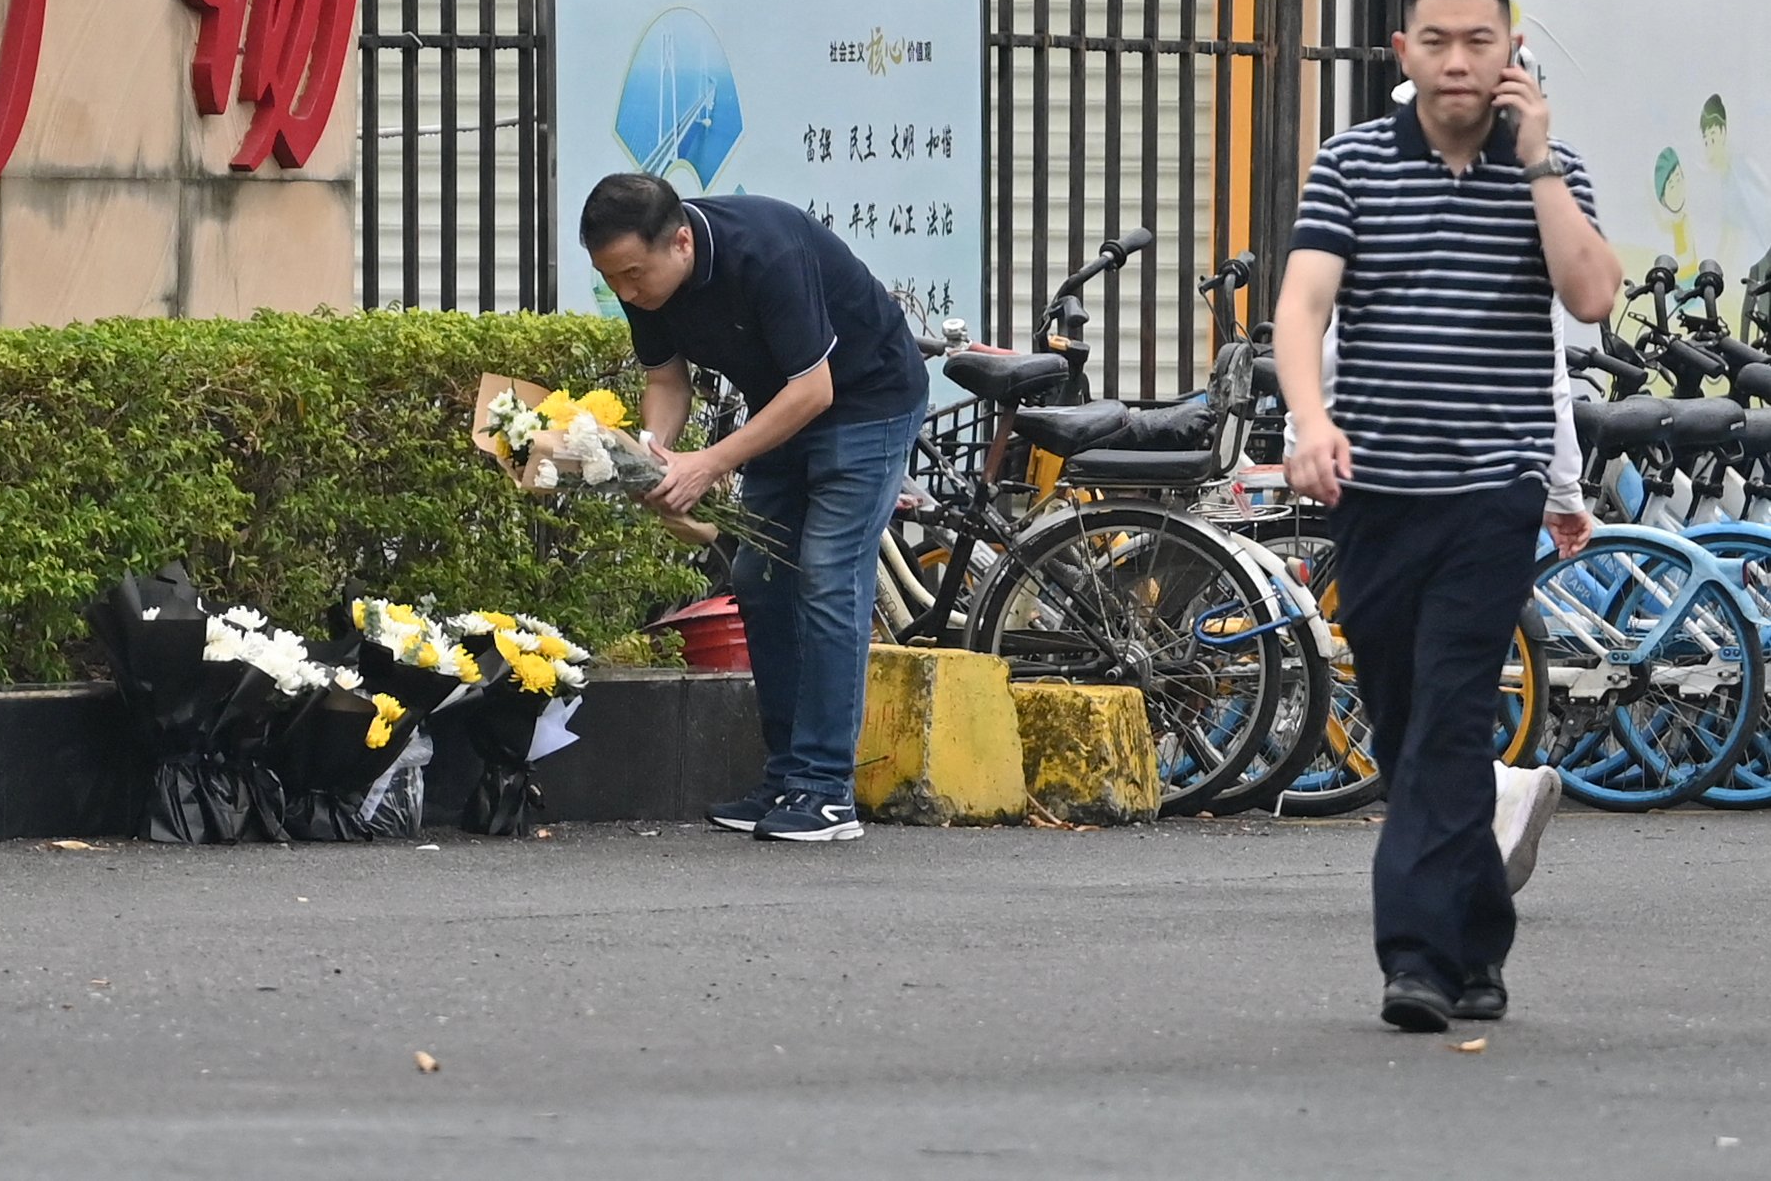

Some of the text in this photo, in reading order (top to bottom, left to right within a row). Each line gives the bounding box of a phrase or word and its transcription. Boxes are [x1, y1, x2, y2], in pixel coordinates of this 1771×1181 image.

[829, 26, 932, 77] 社会主义核心价值观
[803, 123, 953, 163] 富强 民主 文明 和谐
[848, 202, 878, 240] 平等
[888, 203, 916, 236] 公正
[926, 200, 953, 237] 法治
[926, 278, 955, 316] 友善
